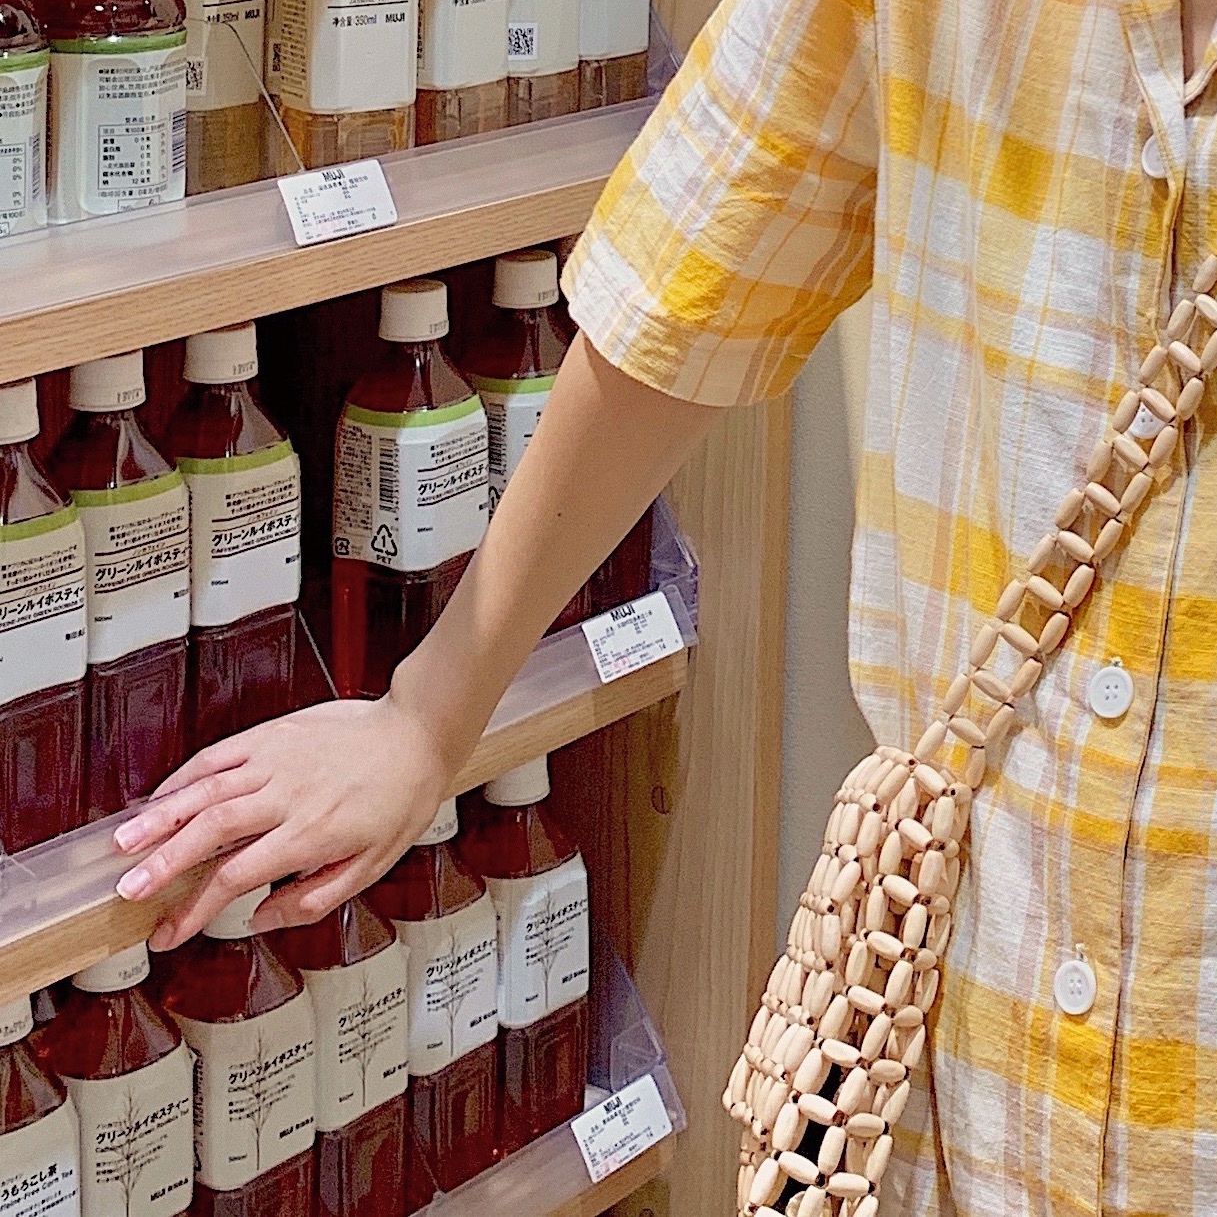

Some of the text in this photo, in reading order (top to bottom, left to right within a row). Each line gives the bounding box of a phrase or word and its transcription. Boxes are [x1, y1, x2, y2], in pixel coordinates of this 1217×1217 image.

[354, 13, 378, 26] 350ml
[385, 12, 406, 24] MUJI
[322, 168, 346, 182] MUJI
[376, 554, 393, 565] PET
[610, 603, 636, 622] MUJI
